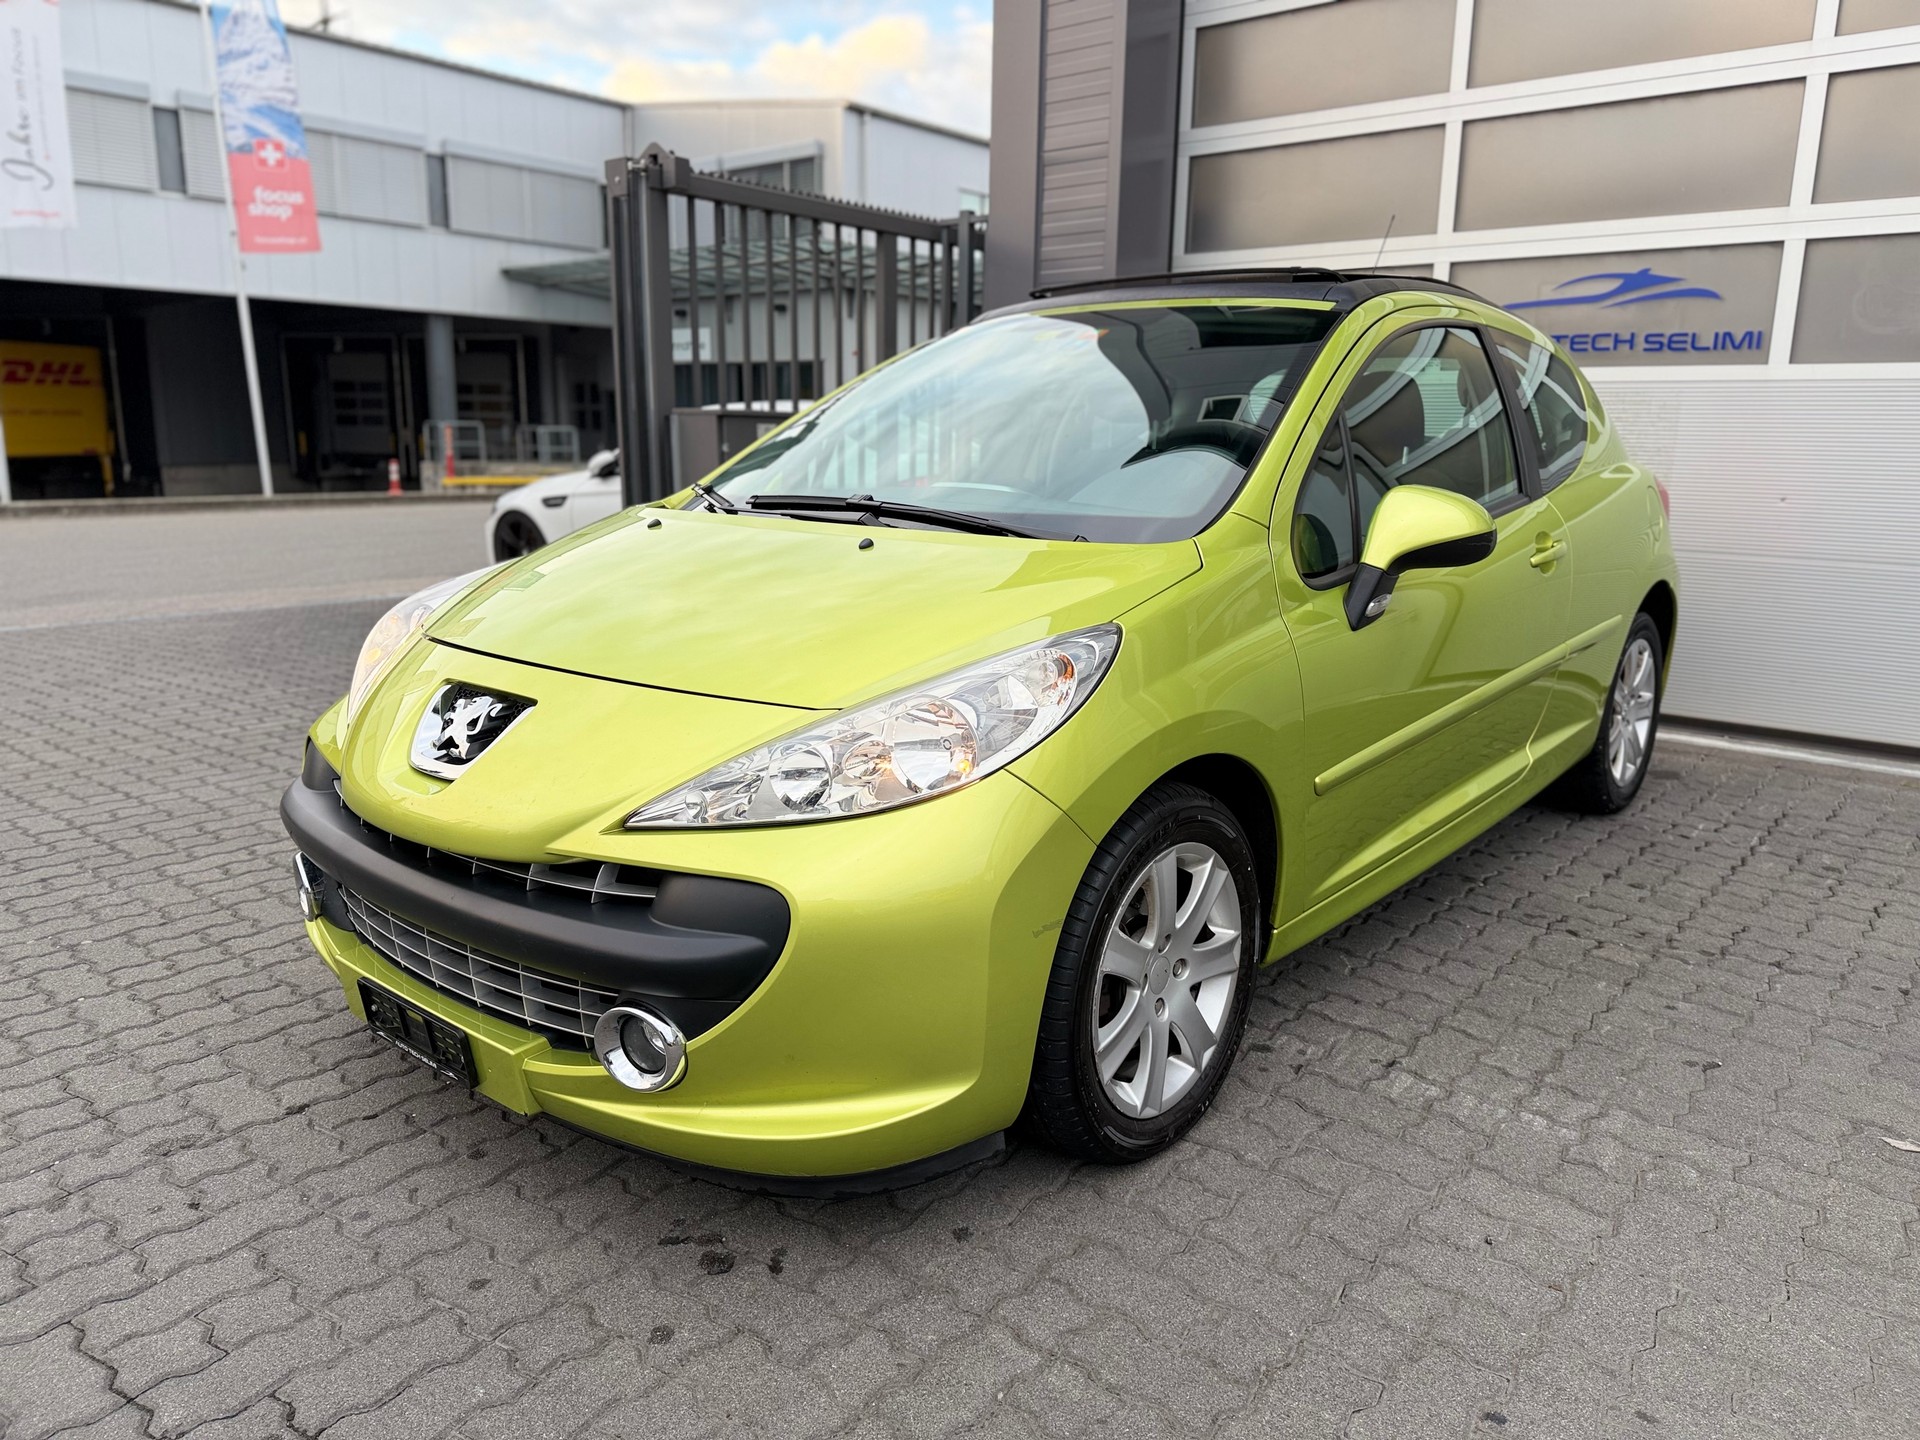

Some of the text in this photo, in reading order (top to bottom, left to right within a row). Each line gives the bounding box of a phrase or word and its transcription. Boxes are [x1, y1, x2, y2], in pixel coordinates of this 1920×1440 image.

[254, 185, 305, 205] focus
[248, 202, 292, 222] shop
[1642, 331, 1763, 352] SELIMI
[3, 360, 90, 385] DHL
